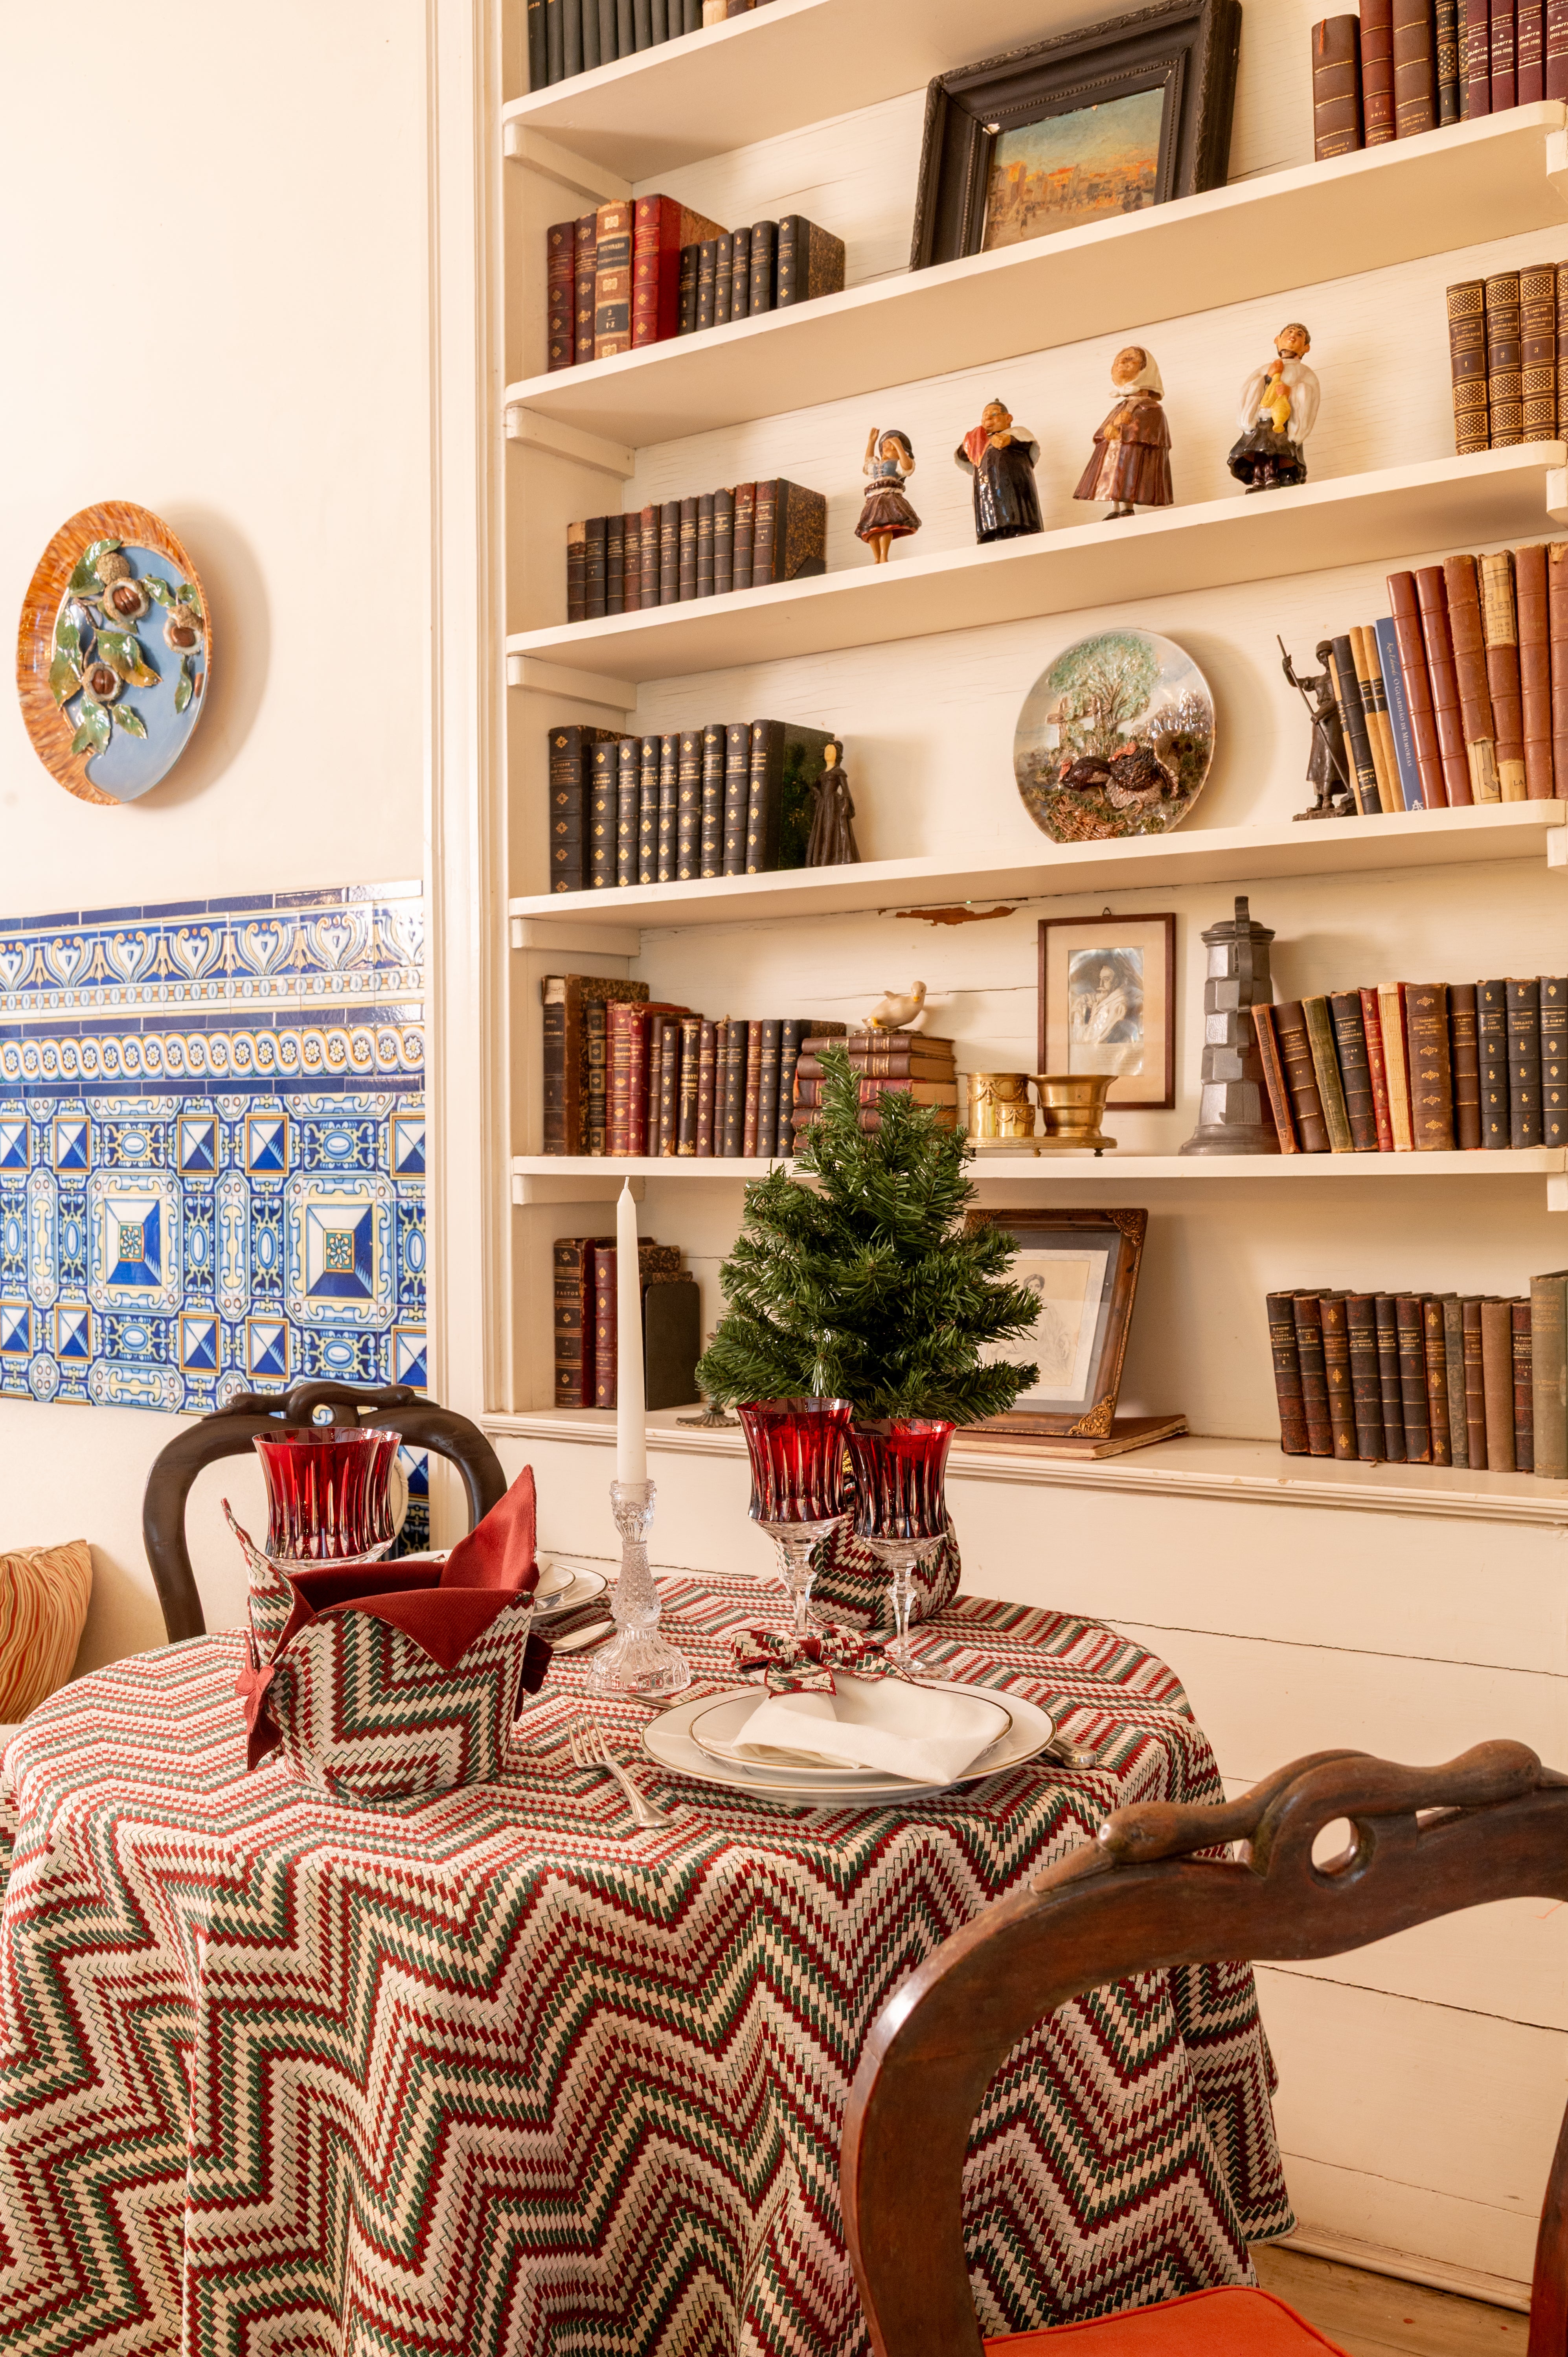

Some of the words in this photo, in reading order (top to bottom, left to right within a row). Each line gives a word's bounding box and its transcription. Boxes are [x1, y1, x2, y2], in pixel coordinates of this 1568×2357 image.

[1518, 31, 1540, 41] guerra
[1491, 39, 1513, 49] guerra
[1519, 39, 1540, 50] (1914-1918)
[1467, 47, 1488, 57] guerra
[1492, 47, 1513, 57] (1914-1918)
[1467, 54, 1488, 65] (1914-1918)
[1487, 601, 1511, 614] LET
[1395, 686, 1405, 721] GUARDIÃO
[1401, 722, 1406, 730] DE
[1402, 732, 1412, 767] MEMÓRIAS
[1265, 1063, 1274, 1076] DOS
[1279, 1130, 1287, 1139] 67
